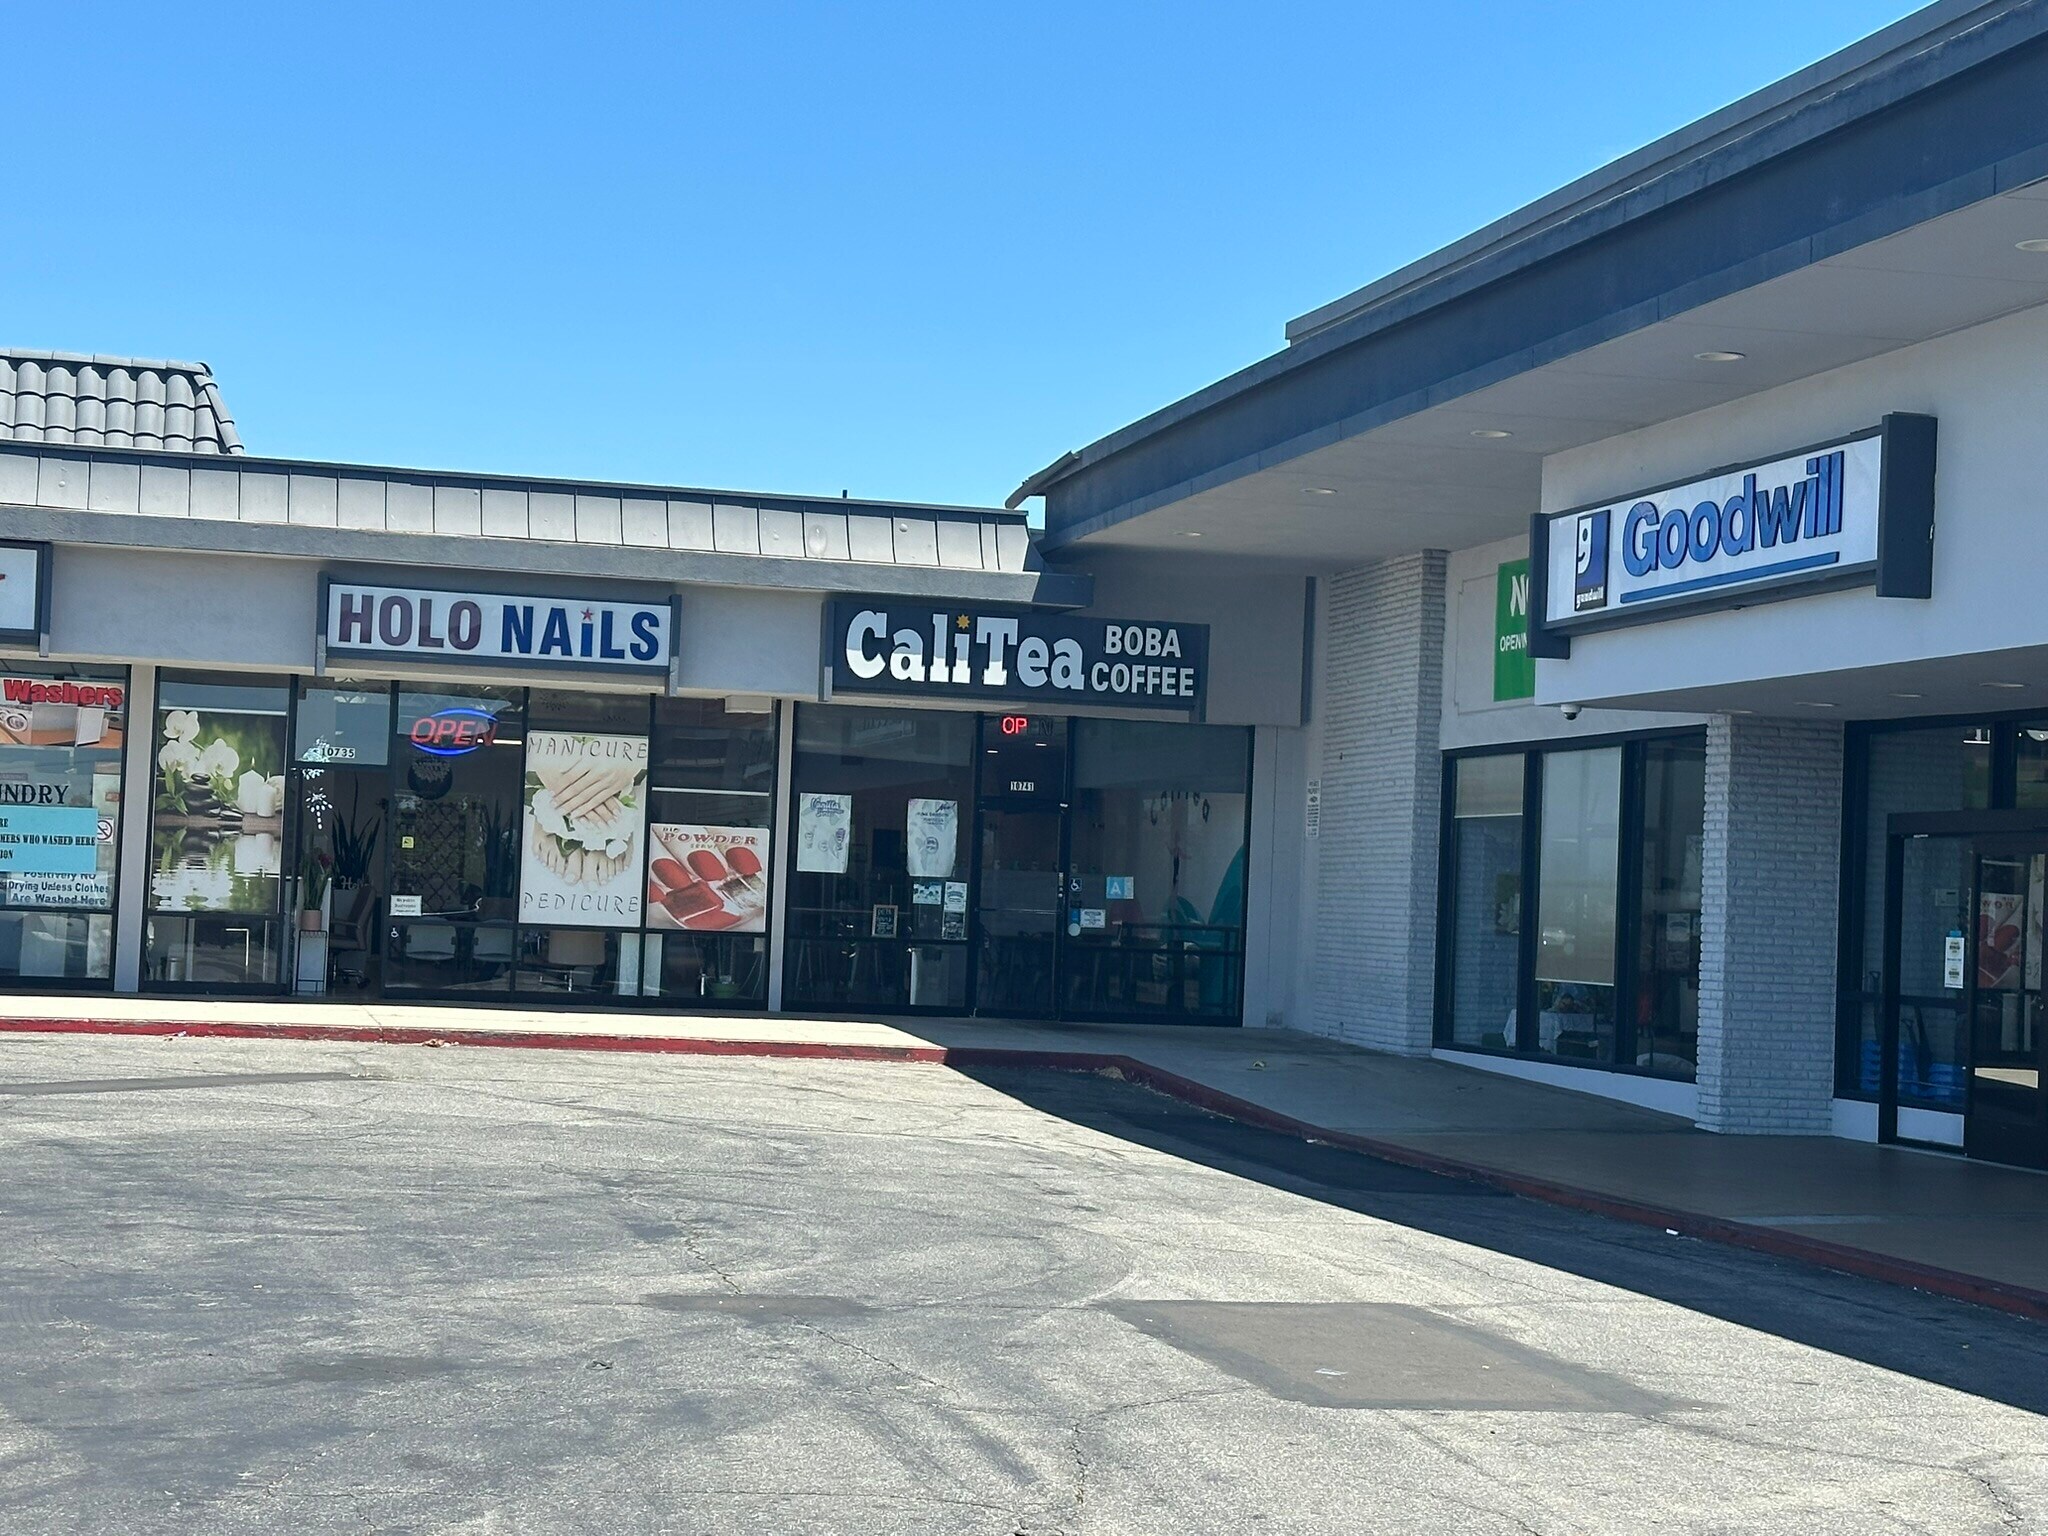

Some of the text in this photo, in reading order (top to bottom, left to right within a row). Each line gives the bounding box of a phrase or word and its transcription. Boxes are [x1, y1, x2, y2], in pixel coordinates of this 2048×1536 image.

[1622, 450, 1844, 577] Goodwill
[1510, 573, 1529, 616] N
[1576, 586, 1604, 609] goodwill
[338, 592, 482, 651] HOLO
[846, 610, 1085, 690] CaliTea
[1104, 625, 1182, 658] BOBA
[1090, 662, 1194, 697] COFFEE
[3, 679, 123, 707] Washers
[410, 717, 498, 747] OPEN
[527, 736, 648, 761] MANICURE
[22, 834, 41, 845] WHO
[42, 834, 74, 846] WASHED
[75, 836, 96, 847] HERE
[663, 832, 757, 845] POWDER
[8, 881, 39, 892] Drying
[41, 881, 72, 892] Unless
[75, 882, 110, 893] Clothes
[12, 893, 107, 905] Are Washed Here
[1110, 881, 1122, 895] A
[523, 891, 640, 915] PEDICURE
